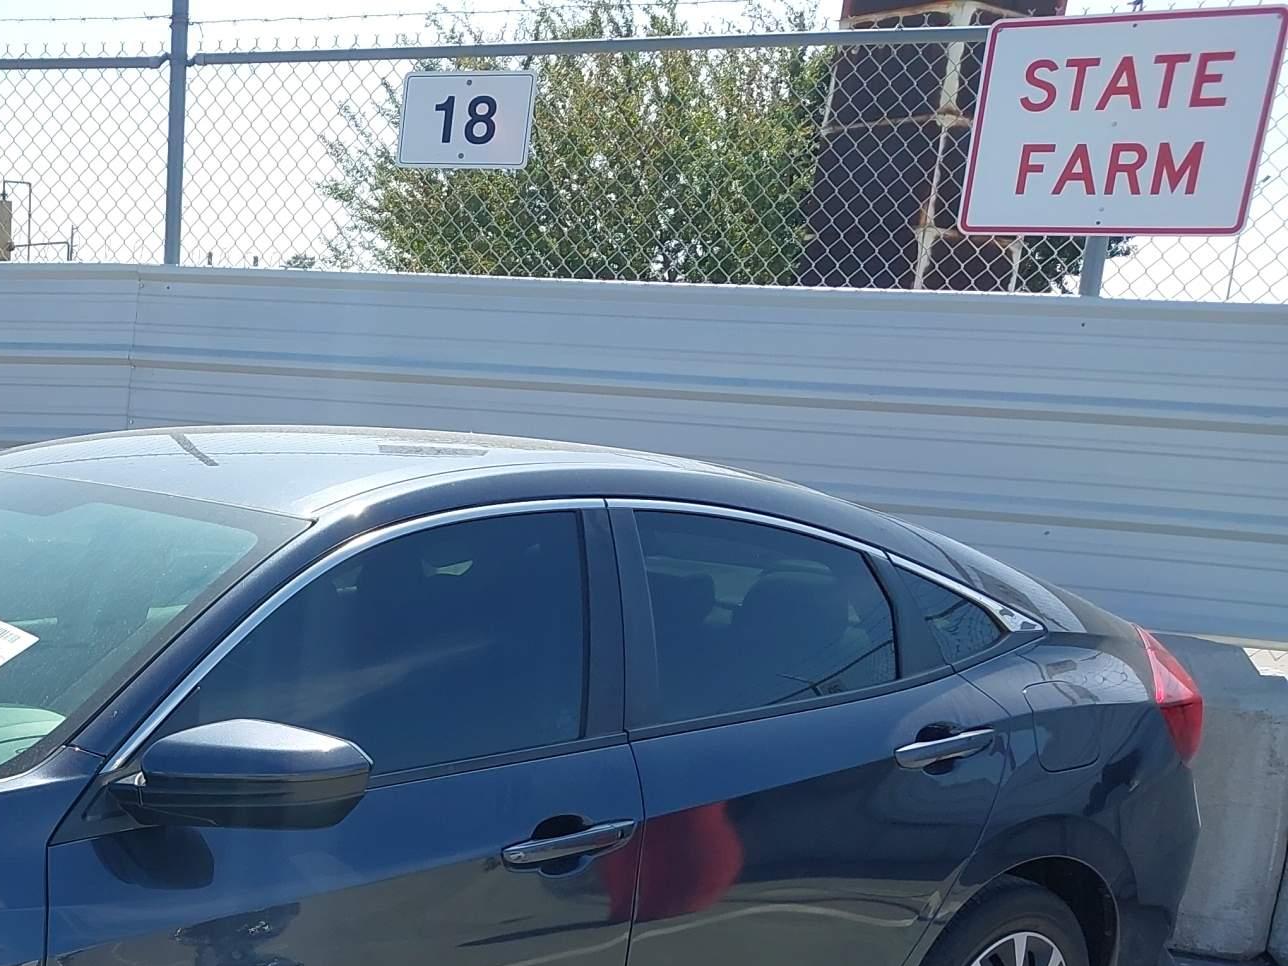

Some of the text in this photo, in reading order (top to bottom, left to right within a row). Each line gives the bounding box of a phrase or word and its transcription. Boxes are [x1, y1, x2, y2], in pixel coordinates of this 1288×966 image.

[1021, 51, 1235, 112] STATE
[434, 95, 497, 145] 18
[1015, 142, 1204, 196] FARM
